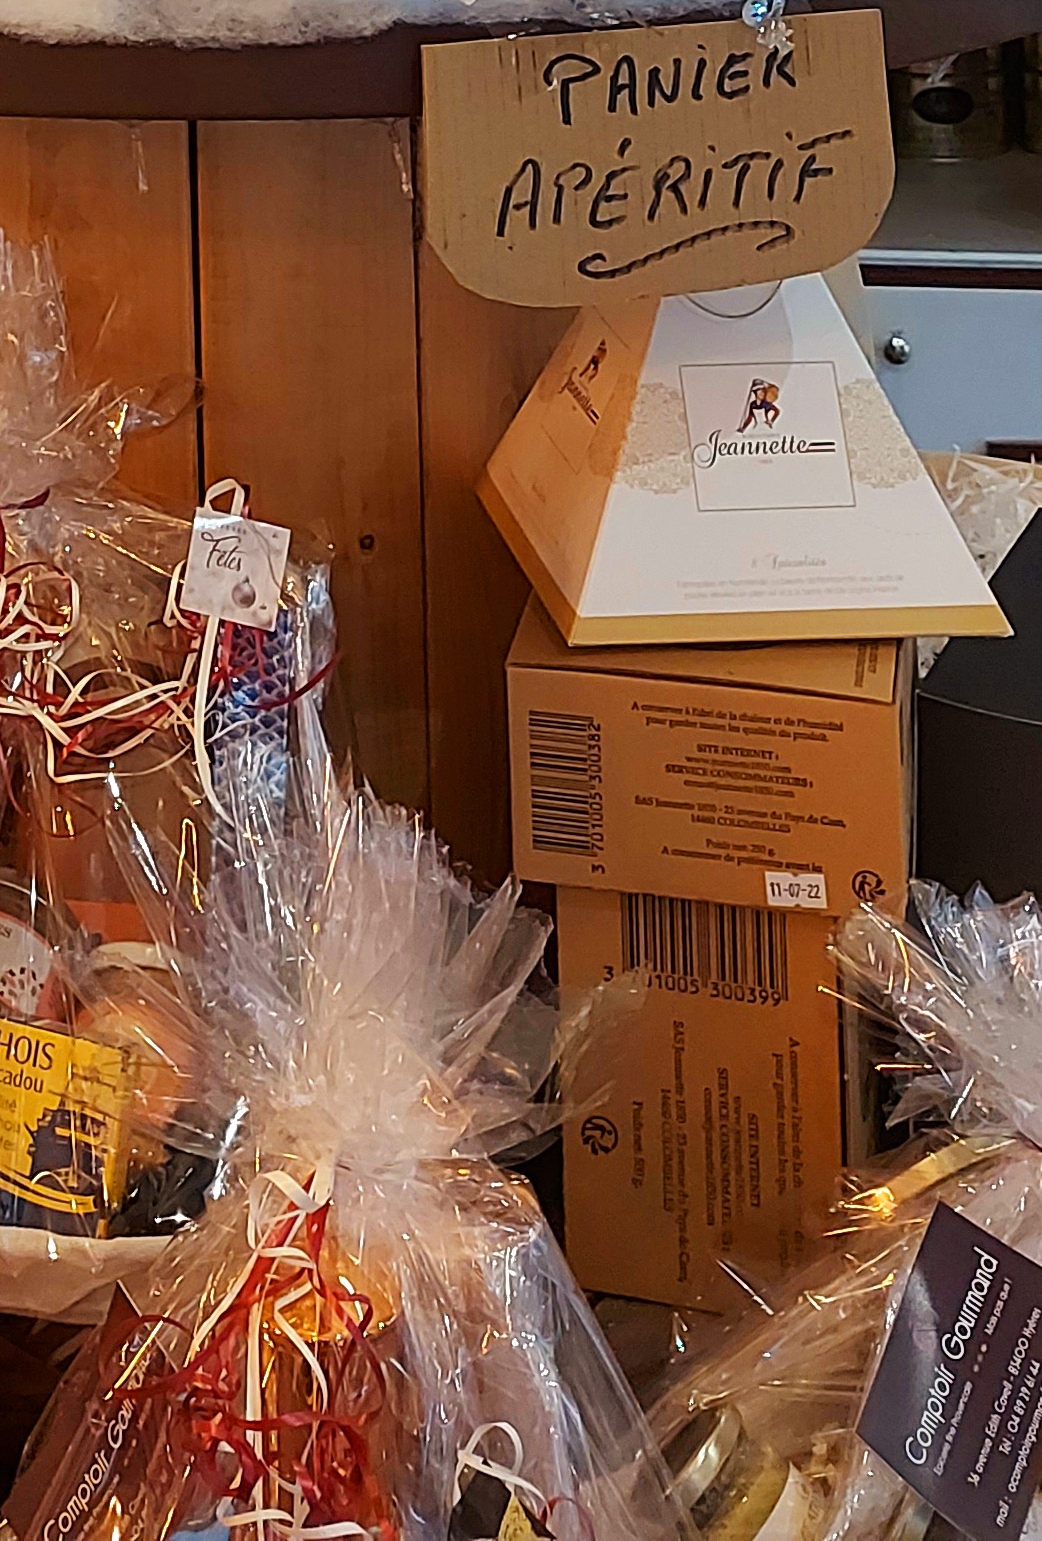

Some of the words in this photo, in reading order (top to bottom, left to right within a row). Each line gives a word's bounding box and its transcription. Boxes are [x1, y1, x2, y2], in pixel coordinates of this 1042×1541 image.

[542, 43, 797, 126] PANIER
[494, 128, 855, 239] APÉRITIF
[693, 428, 811, 469] Jeannette
[588, 721, 603, 784] 300382
[589, 791, 605, 852] 701005
[591, 863, 605, 875] 3
[769, 881, 822, 900] 11-07-22
[710, 981, 782, 1007] 300399
[905, 1362, 956, 1465] Comptoir
[941, 1246, 1000, 1360] Gourmand
[1005, 1413, 1021, 1433] 04
[40, 1448, 117, 1541] Comptoir
